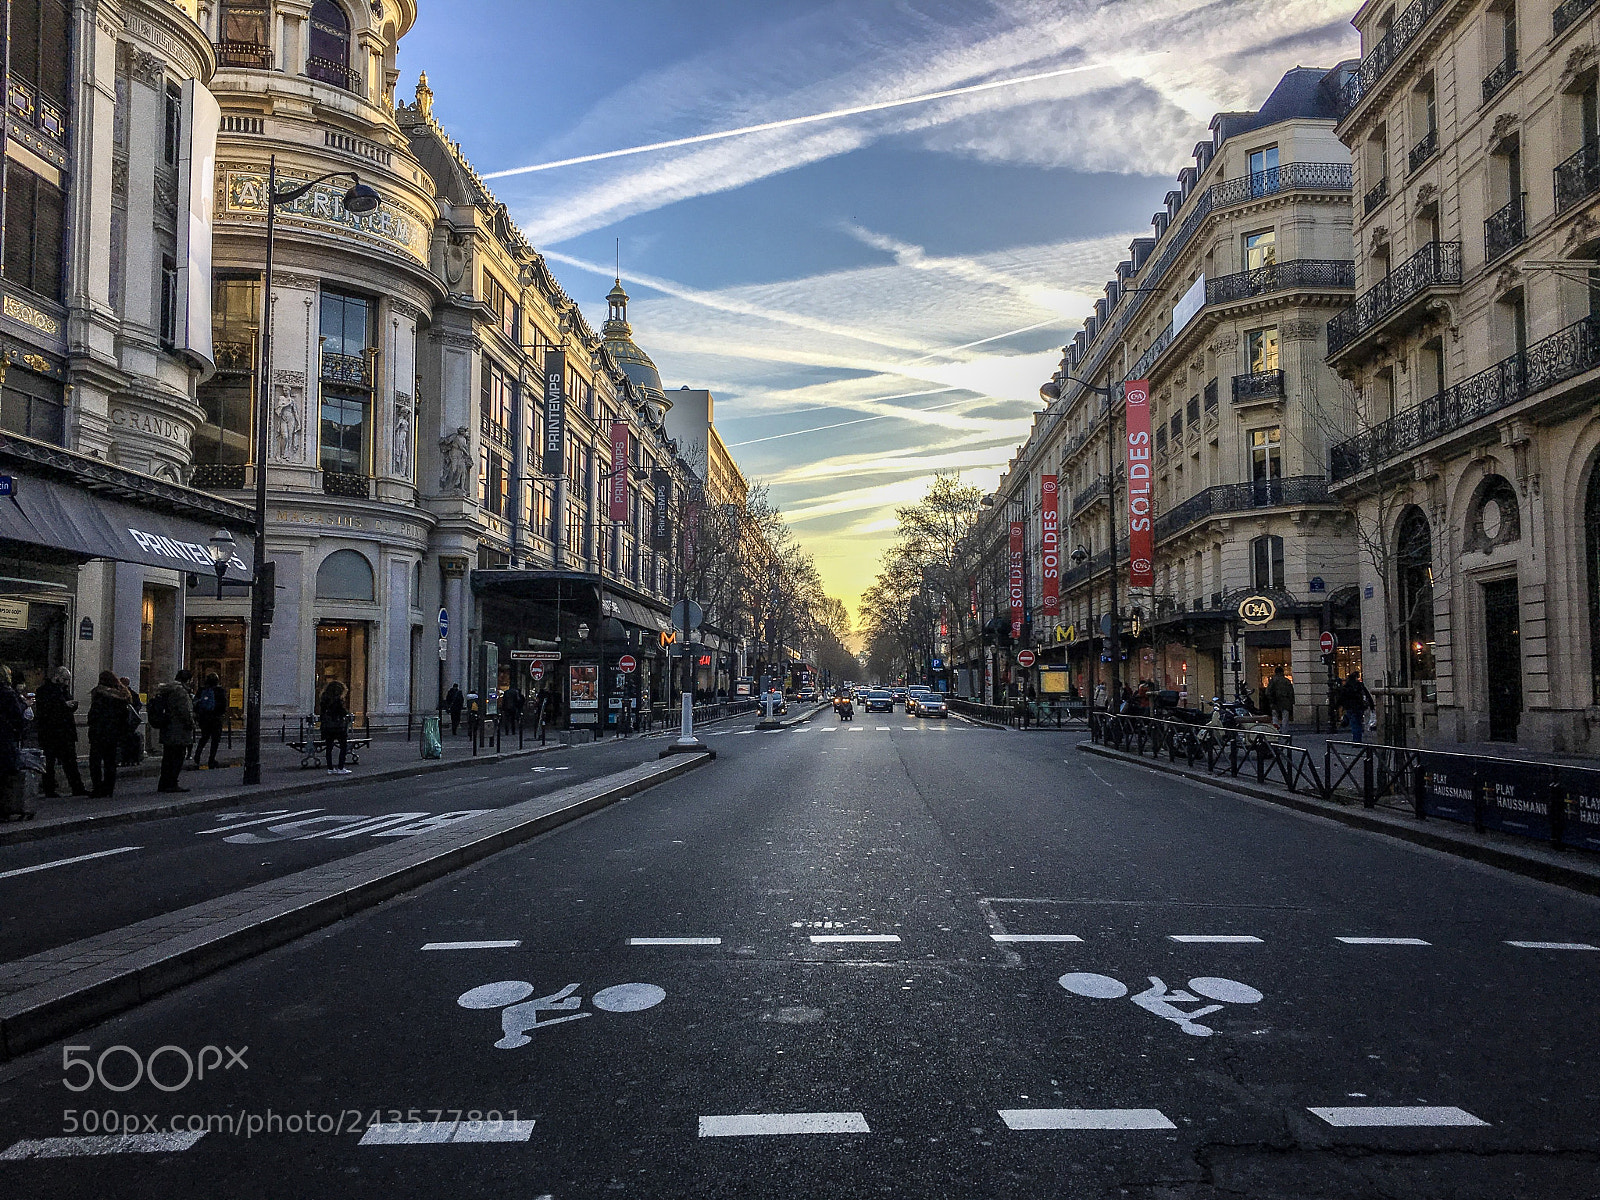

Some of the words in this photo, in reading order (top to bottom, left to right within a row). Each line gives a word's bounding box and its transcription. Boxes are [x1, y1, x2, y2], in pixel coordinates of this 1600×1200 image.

[548, 373, 561, 452] PRINTEMPS
[111, 408, 179, 440] GRANDS
[615, 441, 625, 504] PRINTEMPS
[1129, 431, 1150, 532] SOLDES
[276, 510, 362, 528] MAGASINS
[657, 485, 666, 537] PRINTEMPS
[128, 527, 248, 571] PRINTEMS
[1044, 510, 1058, 578] SOLDES
[1011, 551, 1022, 608] SOLDES
[1244, 602, 1269, 617] C&A
[660, 631, 677, 647] M
[1056, 625, 1075, 642] M
[1433, 773, 1447, 784] PLAY
[1433, 784, 1472, 800] HAUSSMANN
[1495, 783, 1515, 797] PLAY
[1496, 796, 1547, 815] HAUSSMANN
[1580, 810, 1600, 825] HAU
